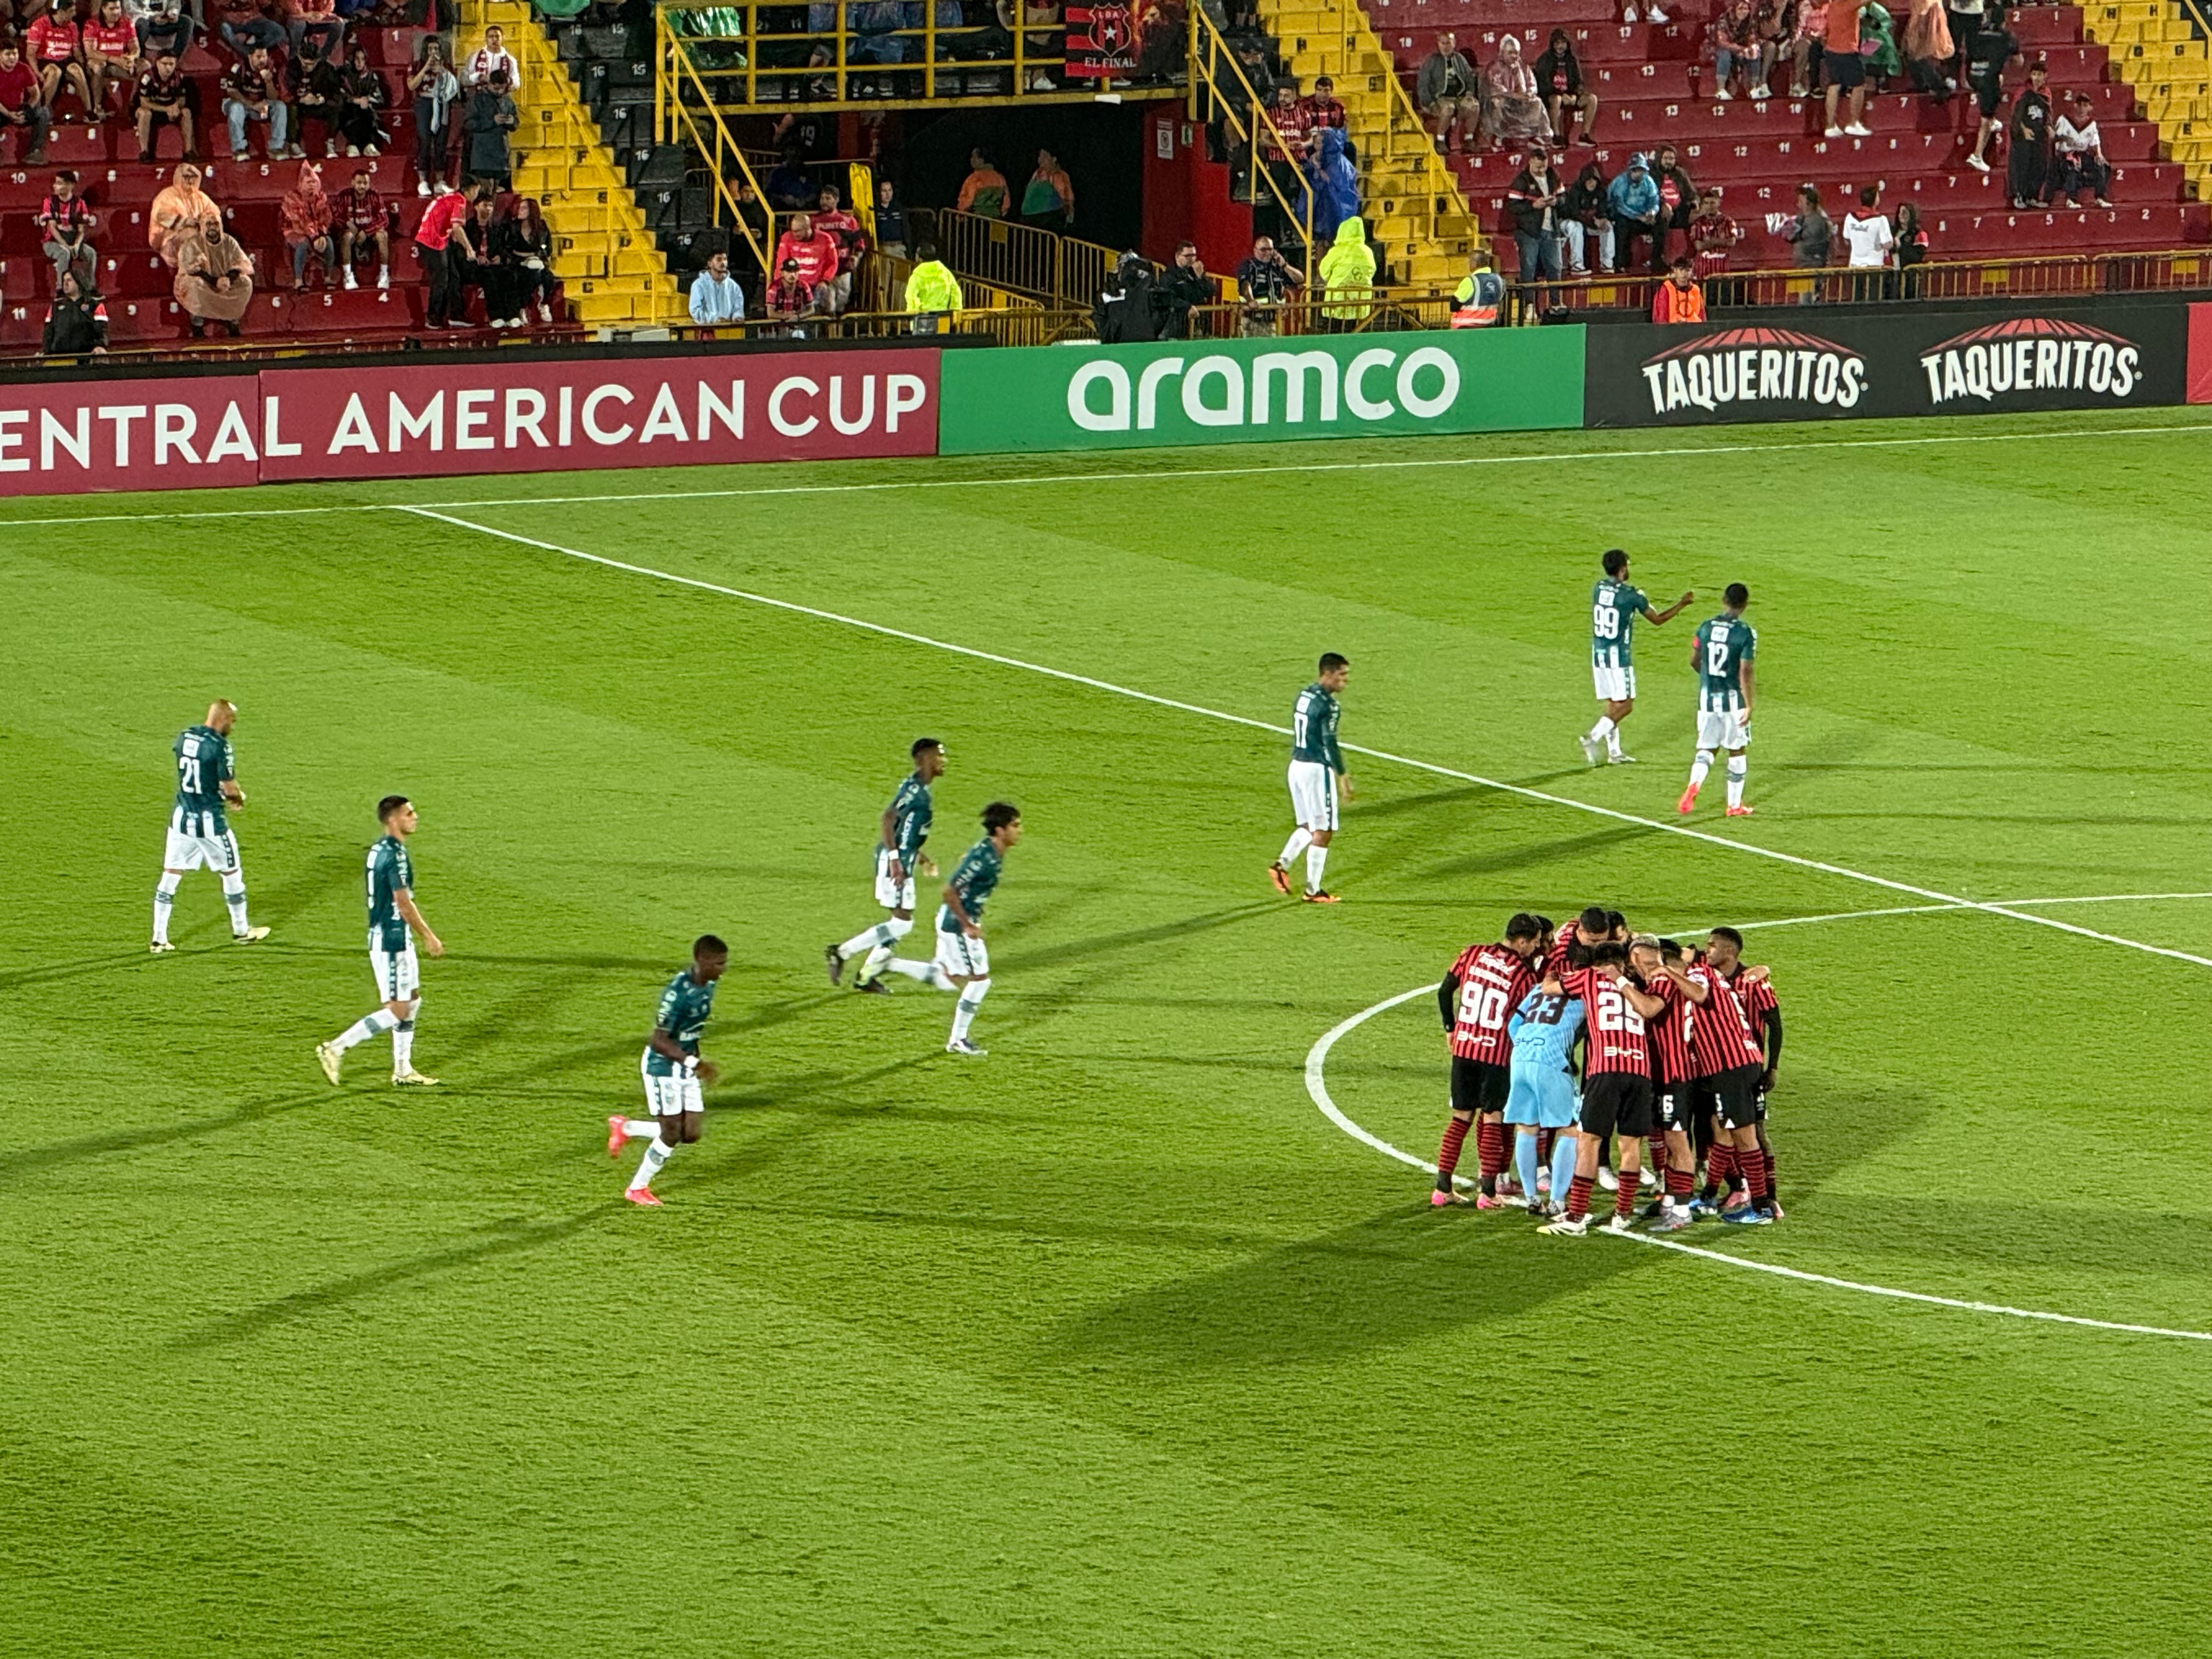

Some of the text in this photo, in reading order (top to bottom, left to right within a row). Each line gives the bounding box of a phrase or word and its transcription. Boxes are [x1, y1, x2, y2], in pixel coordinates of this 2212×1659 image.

[2013, 11, 2020, 21] 2
[2054, 11, 2058, 20] 1
[571, 25, 582, 35] 16
[611, 23, 624, 35] 15
[1666, 26, 1678, 37] 12
[199, 37, 208, 48] 5
[392, 32, 399, 42] 1
[2039, 51, 2046, 61] 2
[2079, 50, 2084, 60] 1
[1085, 57, 1137, 68] EL FINAL
[592, 66, 605, 77] 16
[632, 64, 646, 76] 15
[111, 81, 120, 93] 7
[2064, 90, 2072, 100] 2
[2106, 88, 2111, 99] 1
[1754, 103, 1767, 113] 11
[1900, 97, 1908, 108] 7
[613, 108, 627, 119] 16
[1620, 110, 1633, 120] 14
[1713, 106, 1725, 116] 12
[393, 116, 402, 126] 2
[2130, 128, 2135, 138] 1
[1924, 136, 1932, 146] 7
[1734, 146, 1747, 157] 12
[1779, 142, 1790, 153] 11
[635, 149, 650, 161] 16
[1509, 154, 1522, 165] 17
[1595, 151, 1609, 161] 15
[261, 164, 269, 176] 5
[369, 161, 377, 173] 3
[11, 172, 26, 183] 10
[155, 168, 164, 179] 7
[2117, 170, 2124, 180] 2
[2155, 168, 2160, 179] 1
[1949, 176, 1956, 187] 7
[658, 192, 670, 203] 16
[1757, 188, 1770, 199] 12
[391, 202, 399, 213] 3
[2180, 208, 2185, 218] 1
[2078, 214, 2085, 223] 4
[2108, 211, 2116, 223] 3
[2142, 208, 2150, 219] 2
[1973, 217, 1982, 228] 7
[2008, 216, 2016, 227] 6
[2046, 214, 2053, 225] 5
[411, 247, 419, 258] 3
[108, 260, 116, 270] 9
[273, 296, 281, 308] 6
[324, 295, 332, 307] 5
[379, 292, 388, 302] 4
[12, 308, 26, 320] 11
[127, 305, 137, 316] 9
[1921, 340, 2138, 404] TAQUERITOS
[1643, 349, 1865, 415] TAQUERITOS
[1068, 347, 1460, 431] aramco
[327, 380, 744, 454] AMERICAN
[769, 375, 927, 437] CUP
[1594, 605, 1620, 639] 99
[1707, 642, 1729, 678] 12
[179, 756, 202, 794] 21
[1459, 980, 1509, 1031] 90
[1525, 992, 1568, 1025] 23
[1457, 1030, 1497, 1047] BYD
[1604, 1046, 1644, 1060] BYD
[1663, 1095, 1674, 1114] 6
